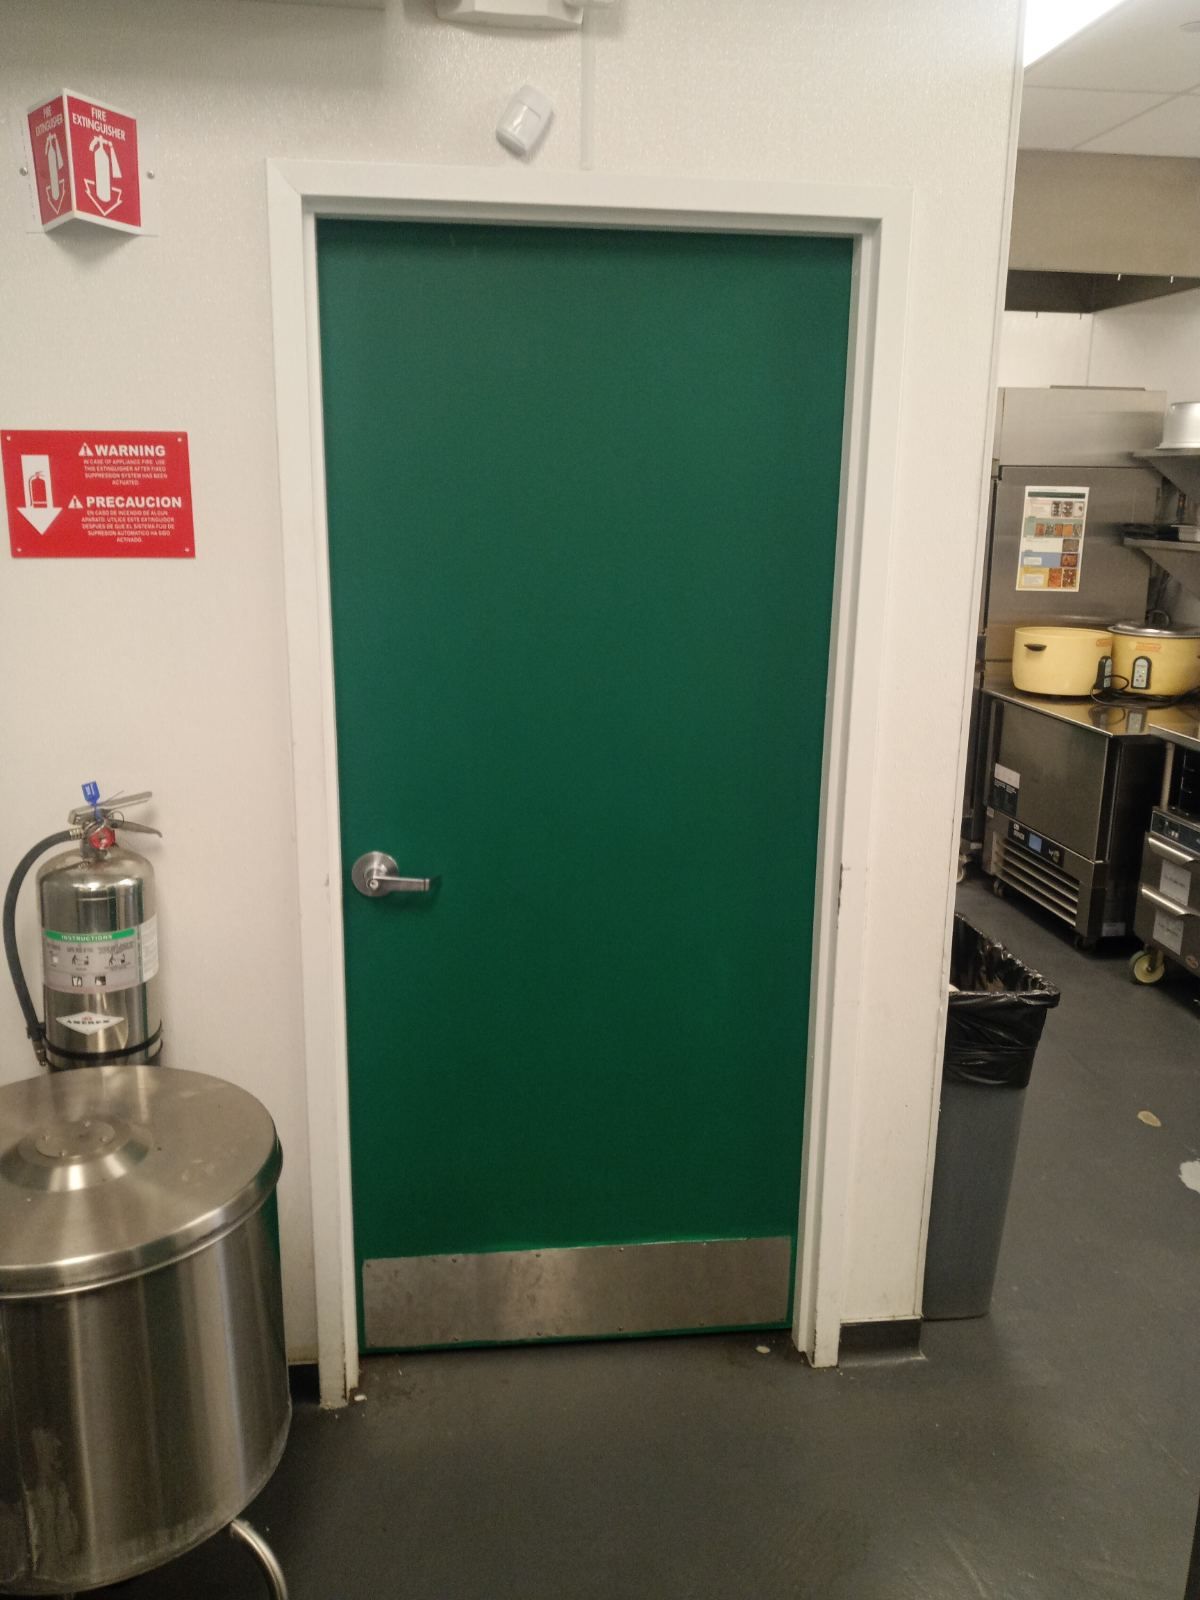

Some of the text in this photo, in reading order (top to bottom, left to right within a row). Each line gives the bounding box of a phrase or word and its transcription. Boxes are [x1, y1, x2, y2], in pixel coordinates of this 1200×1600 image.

[91, 107, 106, 122] FIRE
[72, 112, 126, 141] EXTINGUISHER
[94, 445, 166, 457] WARNING
[86, 496, 182, 509] PRECAUCION
[61, 934, 113, 942] INSTRUCTIONS
